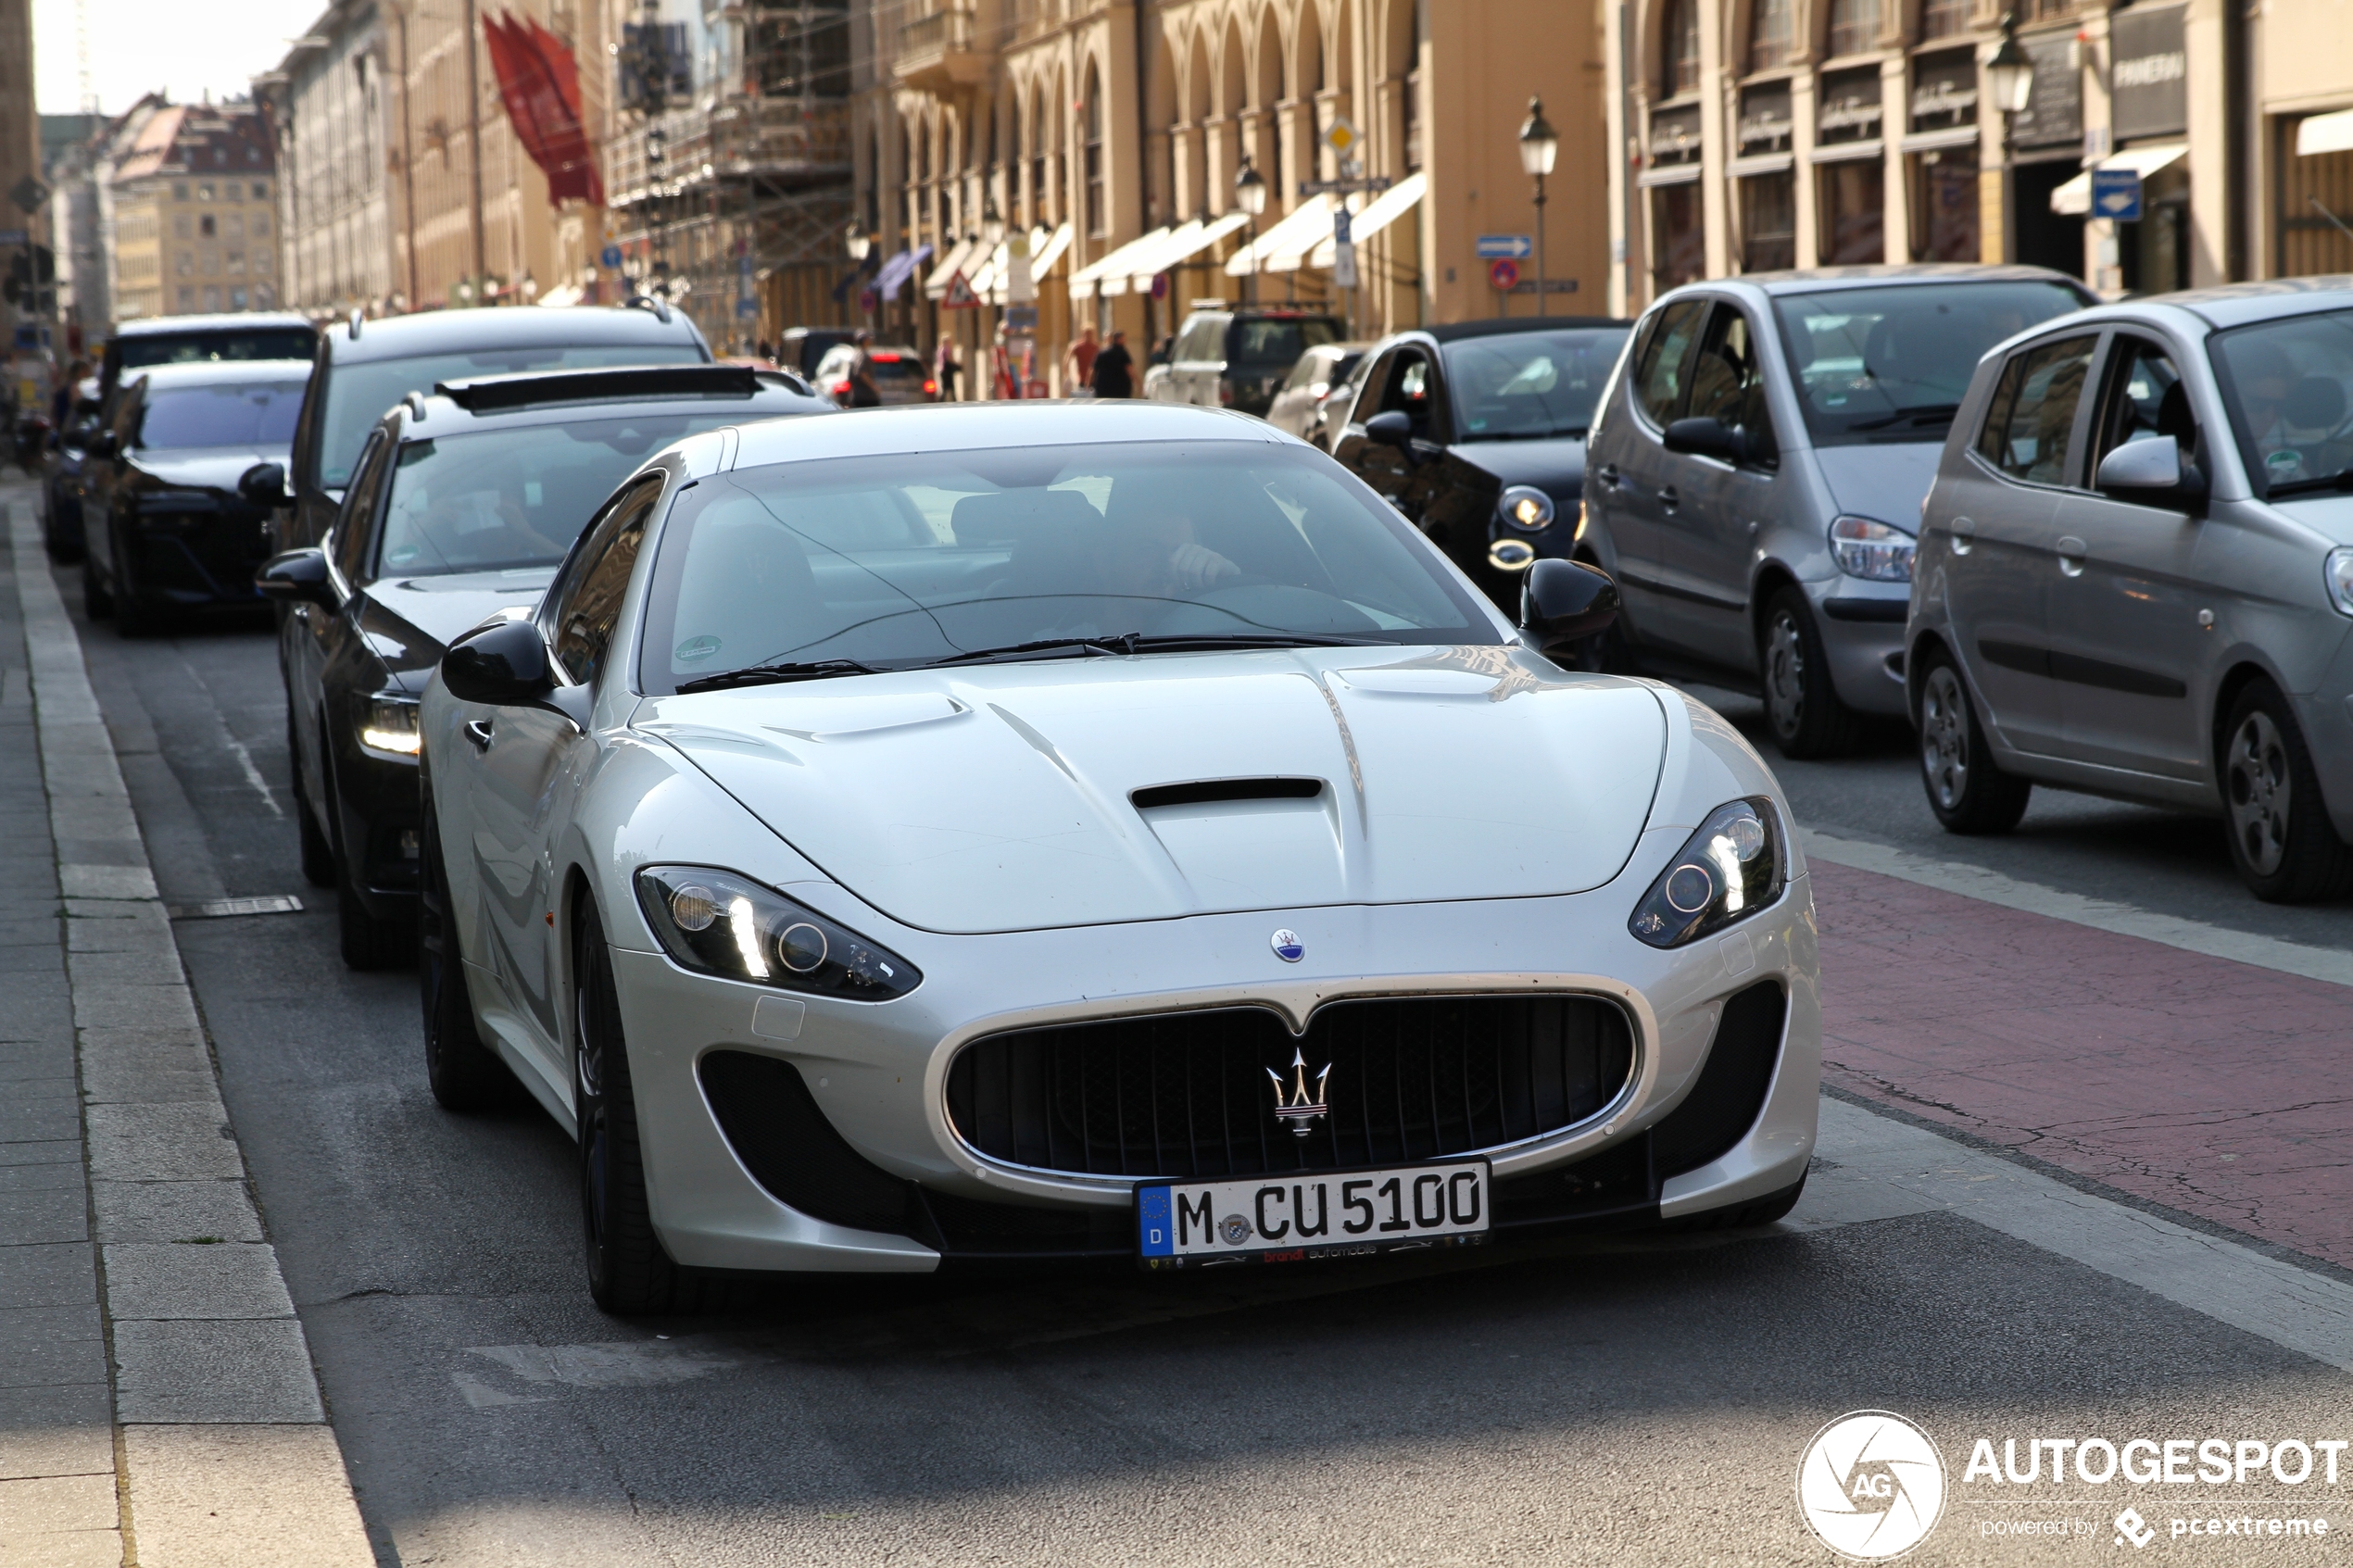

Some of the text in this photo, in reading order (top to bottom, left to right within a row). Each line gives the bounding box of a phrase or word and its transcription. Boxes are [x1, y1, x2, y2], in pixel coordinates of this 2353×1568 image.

[1177, 1191, 1214, 1246] M
[1254, 1183, 1328, 1240] CU
[1342, 1172, 1480, 1235] 5100
[1150, 1228, 1162, 1245] D
[1264, 1244, 1377, 1262] brandl automobile
